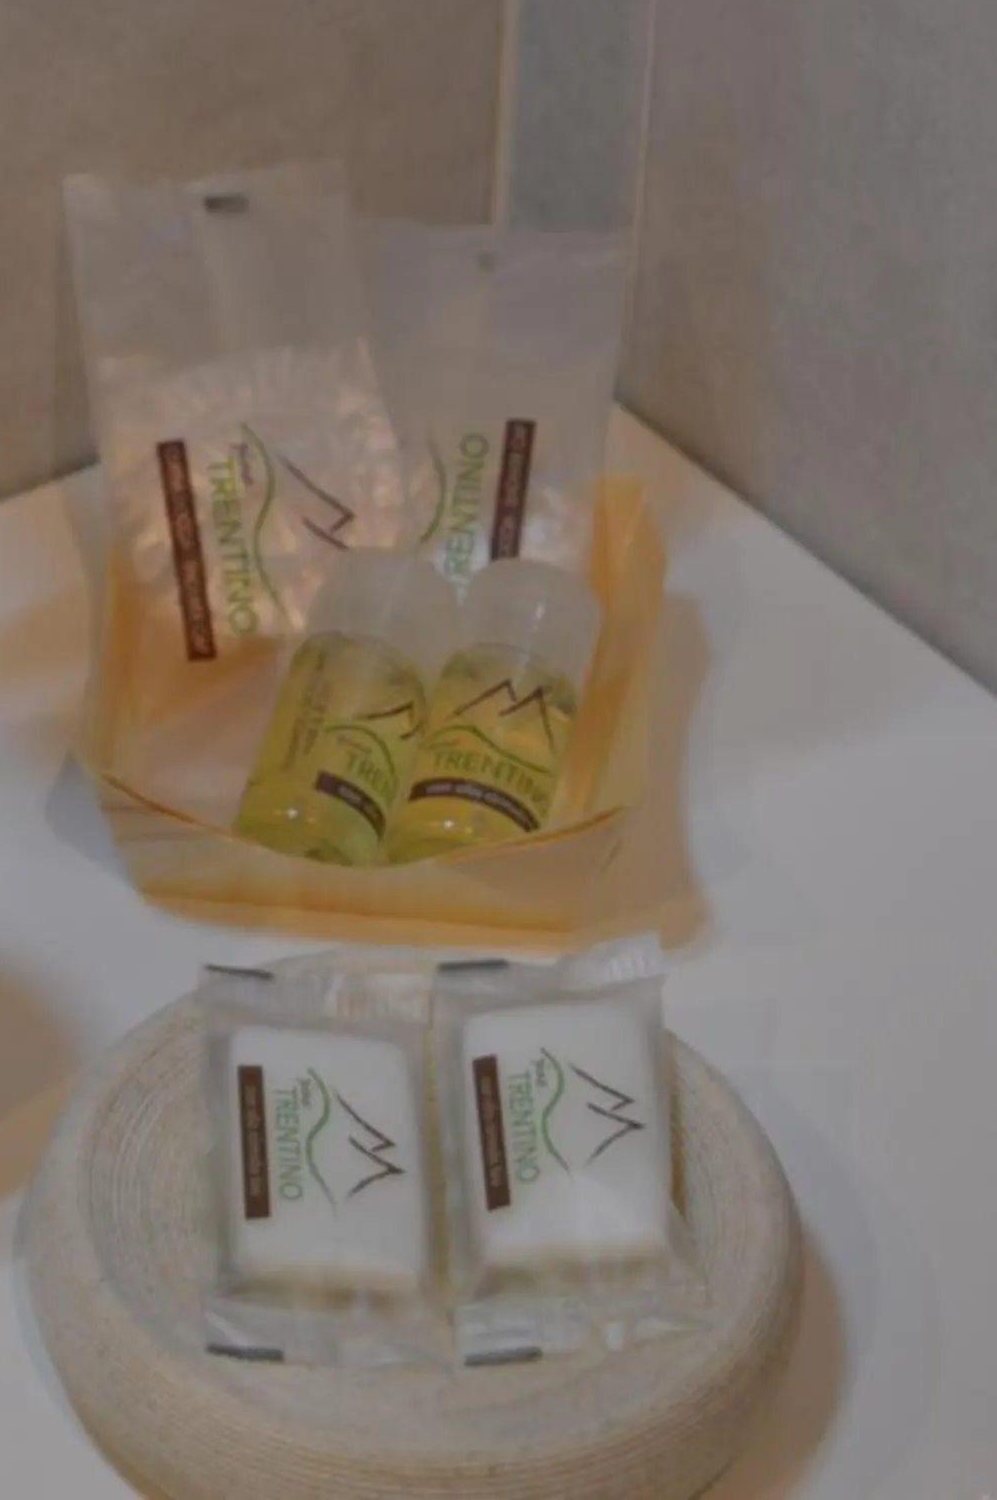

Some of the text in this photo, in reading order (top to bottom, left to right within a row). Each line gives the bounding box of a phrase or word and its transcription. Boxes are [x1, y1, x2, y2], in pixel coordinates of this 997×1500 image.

[206, 457, 260, 637] TRENTINO
[443, 431, 490, 578] RENTINO
[274, 1086, 303, 1202] TRENTINO
[509, 1071, 541, 1185] TRENTINO
